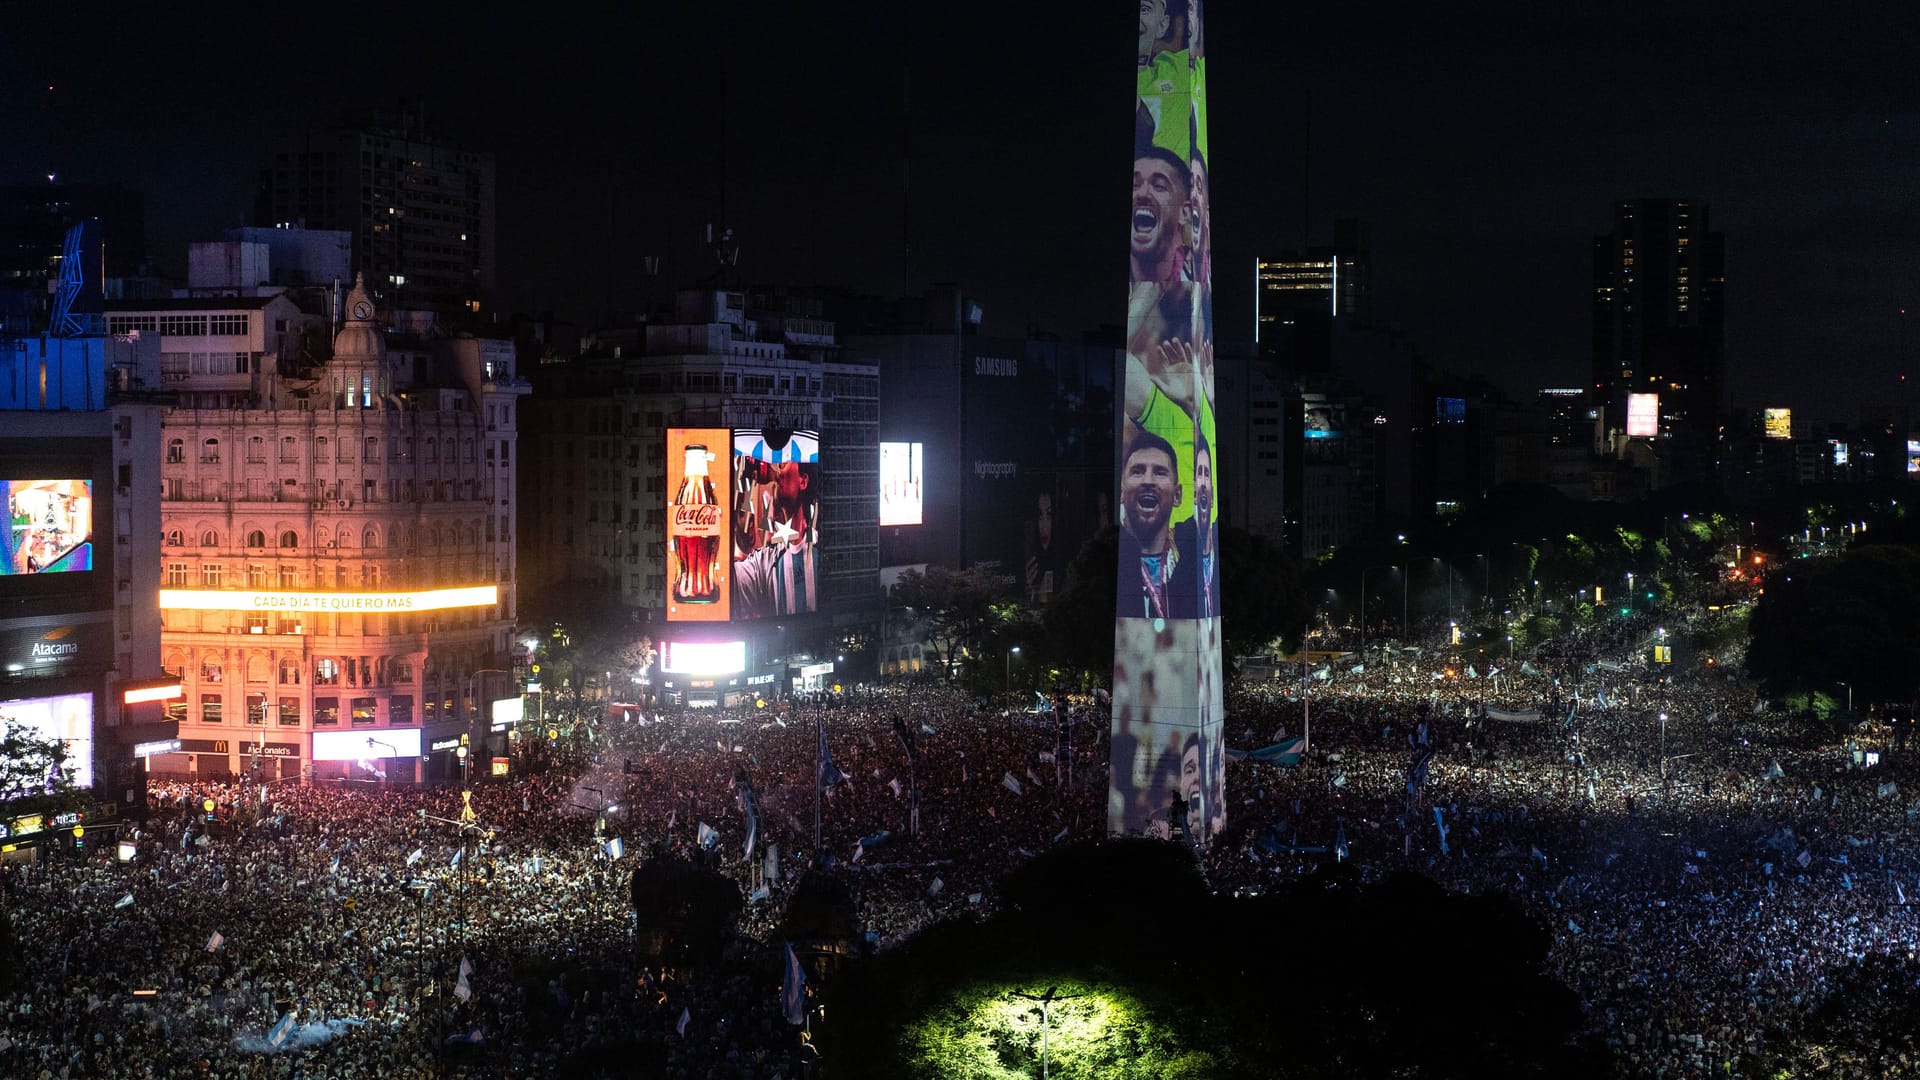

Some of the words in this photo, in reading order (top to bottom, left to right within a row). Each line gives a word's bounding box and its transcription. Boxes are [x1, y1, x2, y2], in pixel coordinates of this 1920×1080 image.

[975, 356, 1018, 377] SAMSUNG
[675, 504, 717, 525] Coca-Cola
[254, 596, 286, 607] CADA
[313, 597, 327, 608] TE
[331, 597, 383, 610] QUIERO
[32, 643, 78, 656] Atacama
